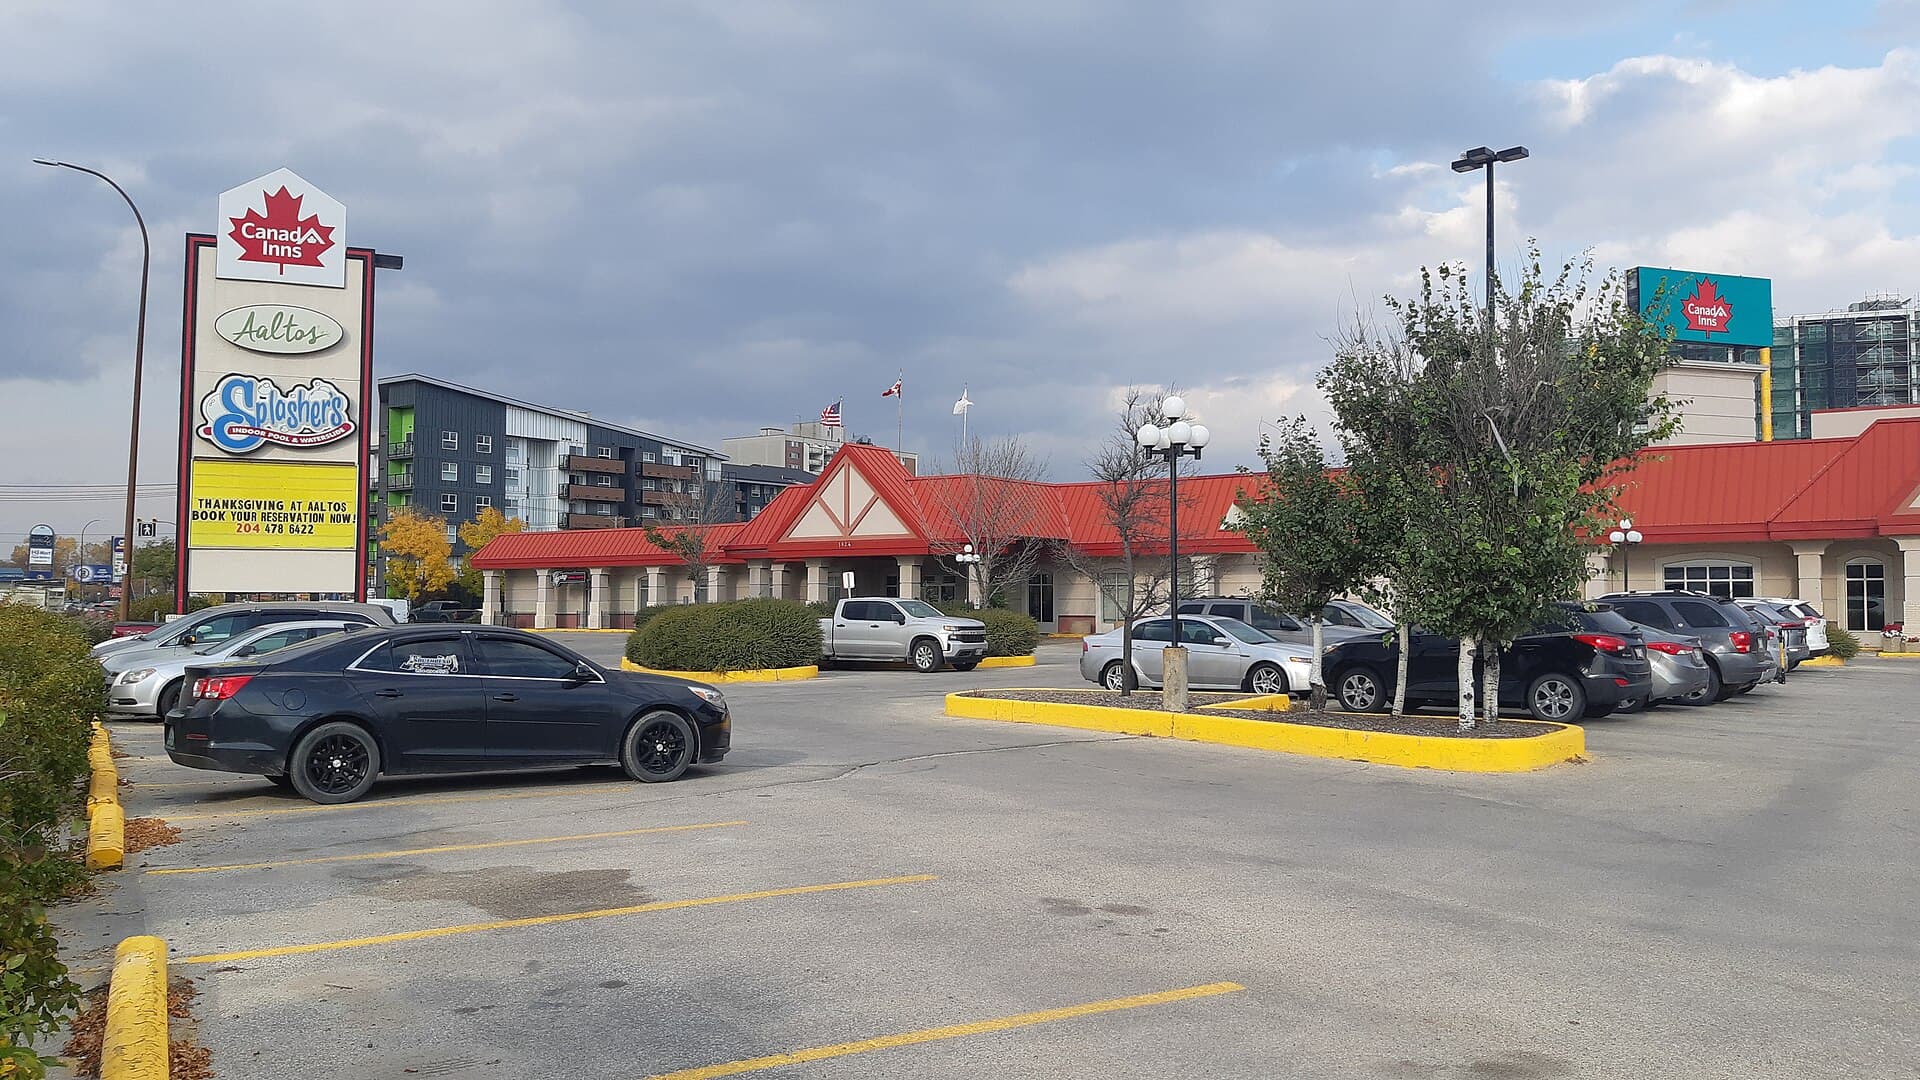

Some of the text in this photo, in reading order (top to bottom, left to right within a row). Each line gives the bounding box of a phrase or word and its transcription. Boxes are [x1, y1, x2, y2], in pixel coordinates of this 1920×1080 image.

[262, 240, 302, 258] Inns
[232, 311, 328, 345] Aaltos
[1698, 315, 1717, 327] Inns
[232, 426, 266, 437] INDOOR
[268, 433, 290, 442] POOL
[300, 428, 346, 443] WATERSLIDE
[198, 498, 347, 513] THANKSGIVING AT AALTOS
[192, 510, 357, 524] BOOK YOUR RESERVATION NOW!
[236, 523, 314, 535] 204 478 6422
